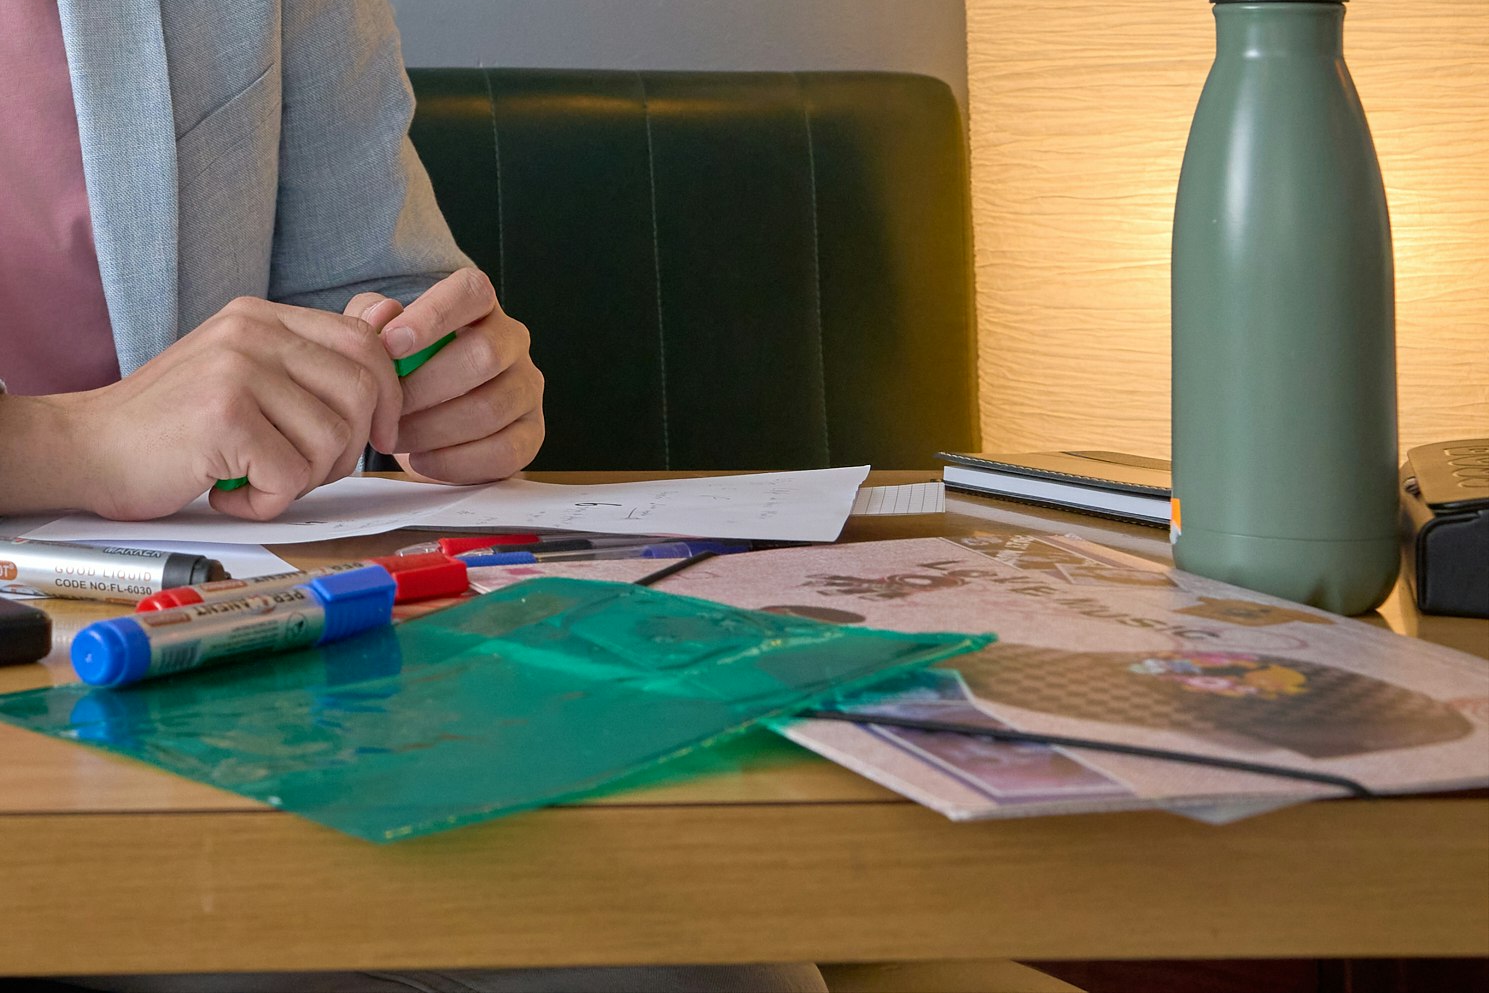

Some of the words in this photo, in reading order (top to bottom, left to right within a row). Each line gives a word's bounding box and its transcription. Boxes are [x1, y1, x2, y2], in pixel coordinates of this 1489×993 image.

[55, 564, 96, 577] GOOD
[102, 568, 152, 582] LIQUID
[55, 578, 87, 589] CODE
